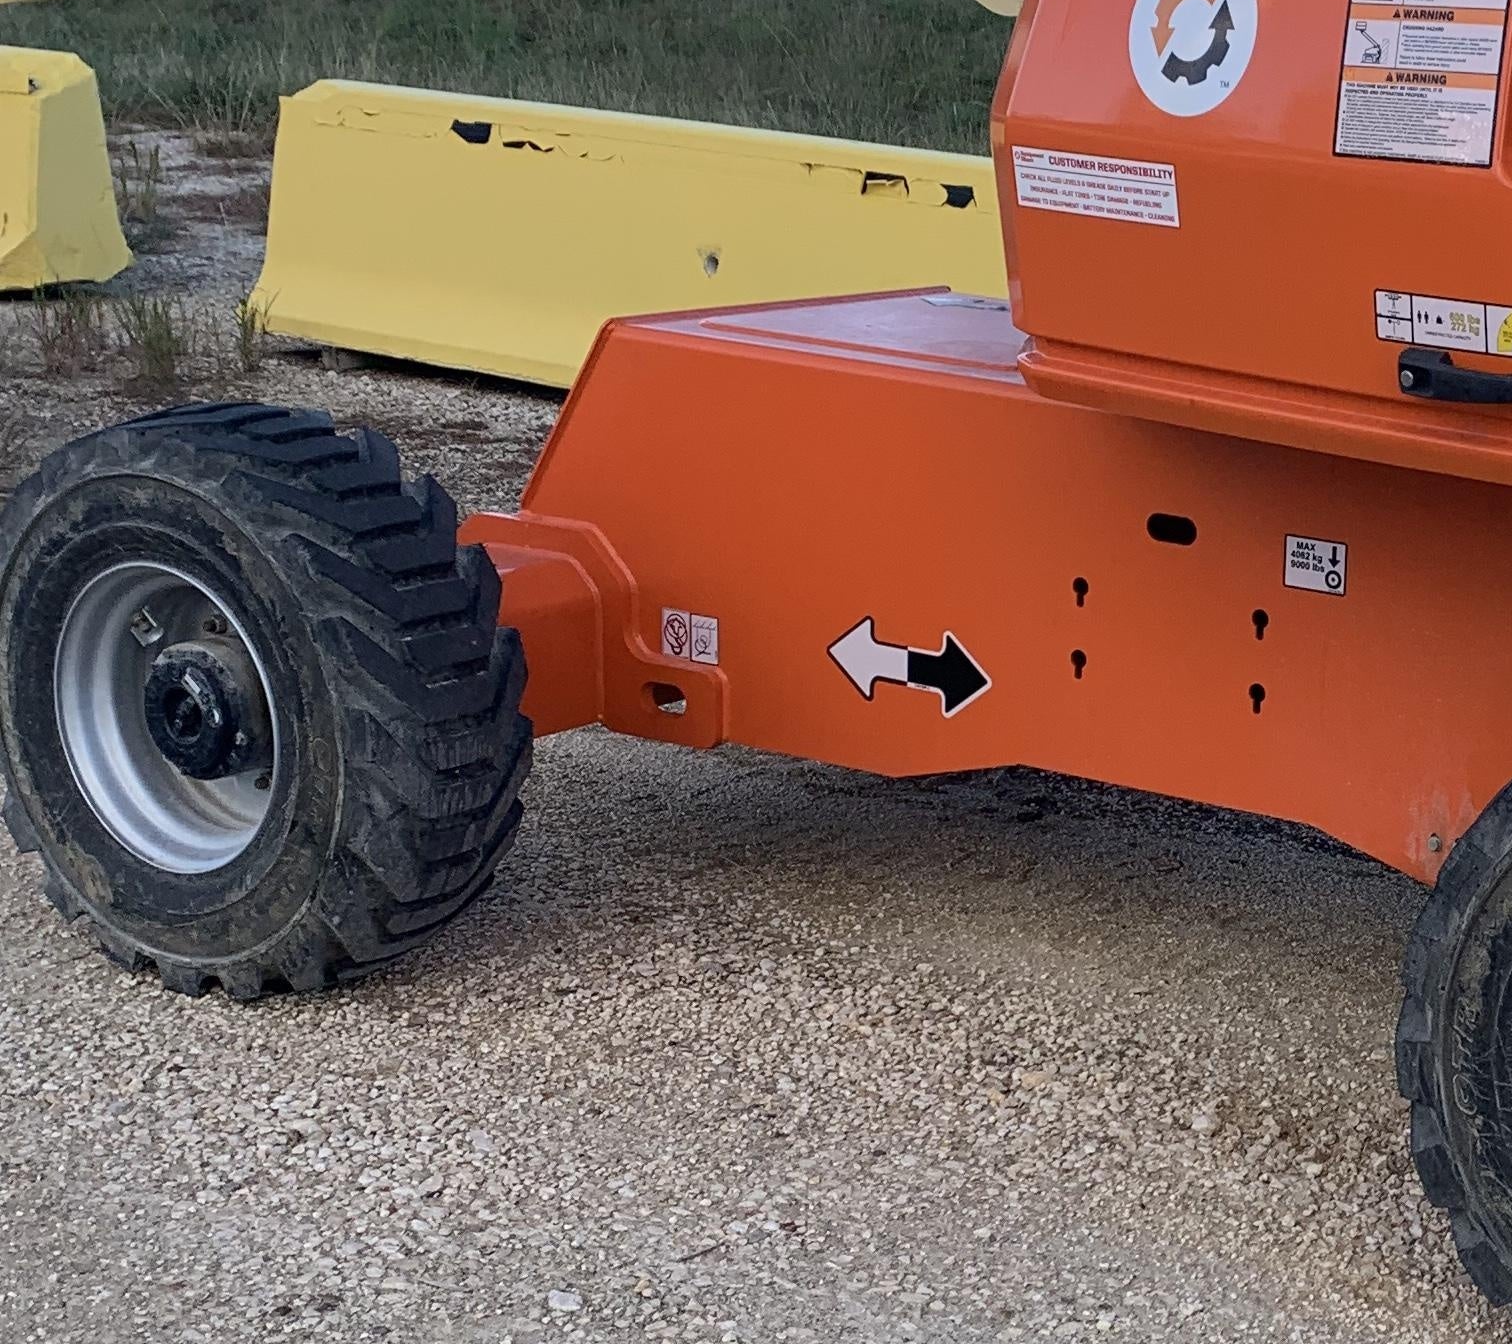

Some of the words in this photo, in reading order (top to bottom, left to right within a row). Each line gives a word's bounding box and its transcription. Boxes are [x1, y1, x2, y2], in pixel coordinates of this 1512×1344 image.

[1403, 9, 1455, 22] WARNING
[1396, 72, 1447, 85] WARNING
[1048, 155, 1096, 171] CUSTOMER
[1097, 162, 1173, 180] RESPONSIBILITY
[1296, 540, 1317, 552] MAX
[1312, 552, 1323, 565] kg
[1290, 559, 1310, 570] 9000
[1312, 562, 1325, 573] lbs
